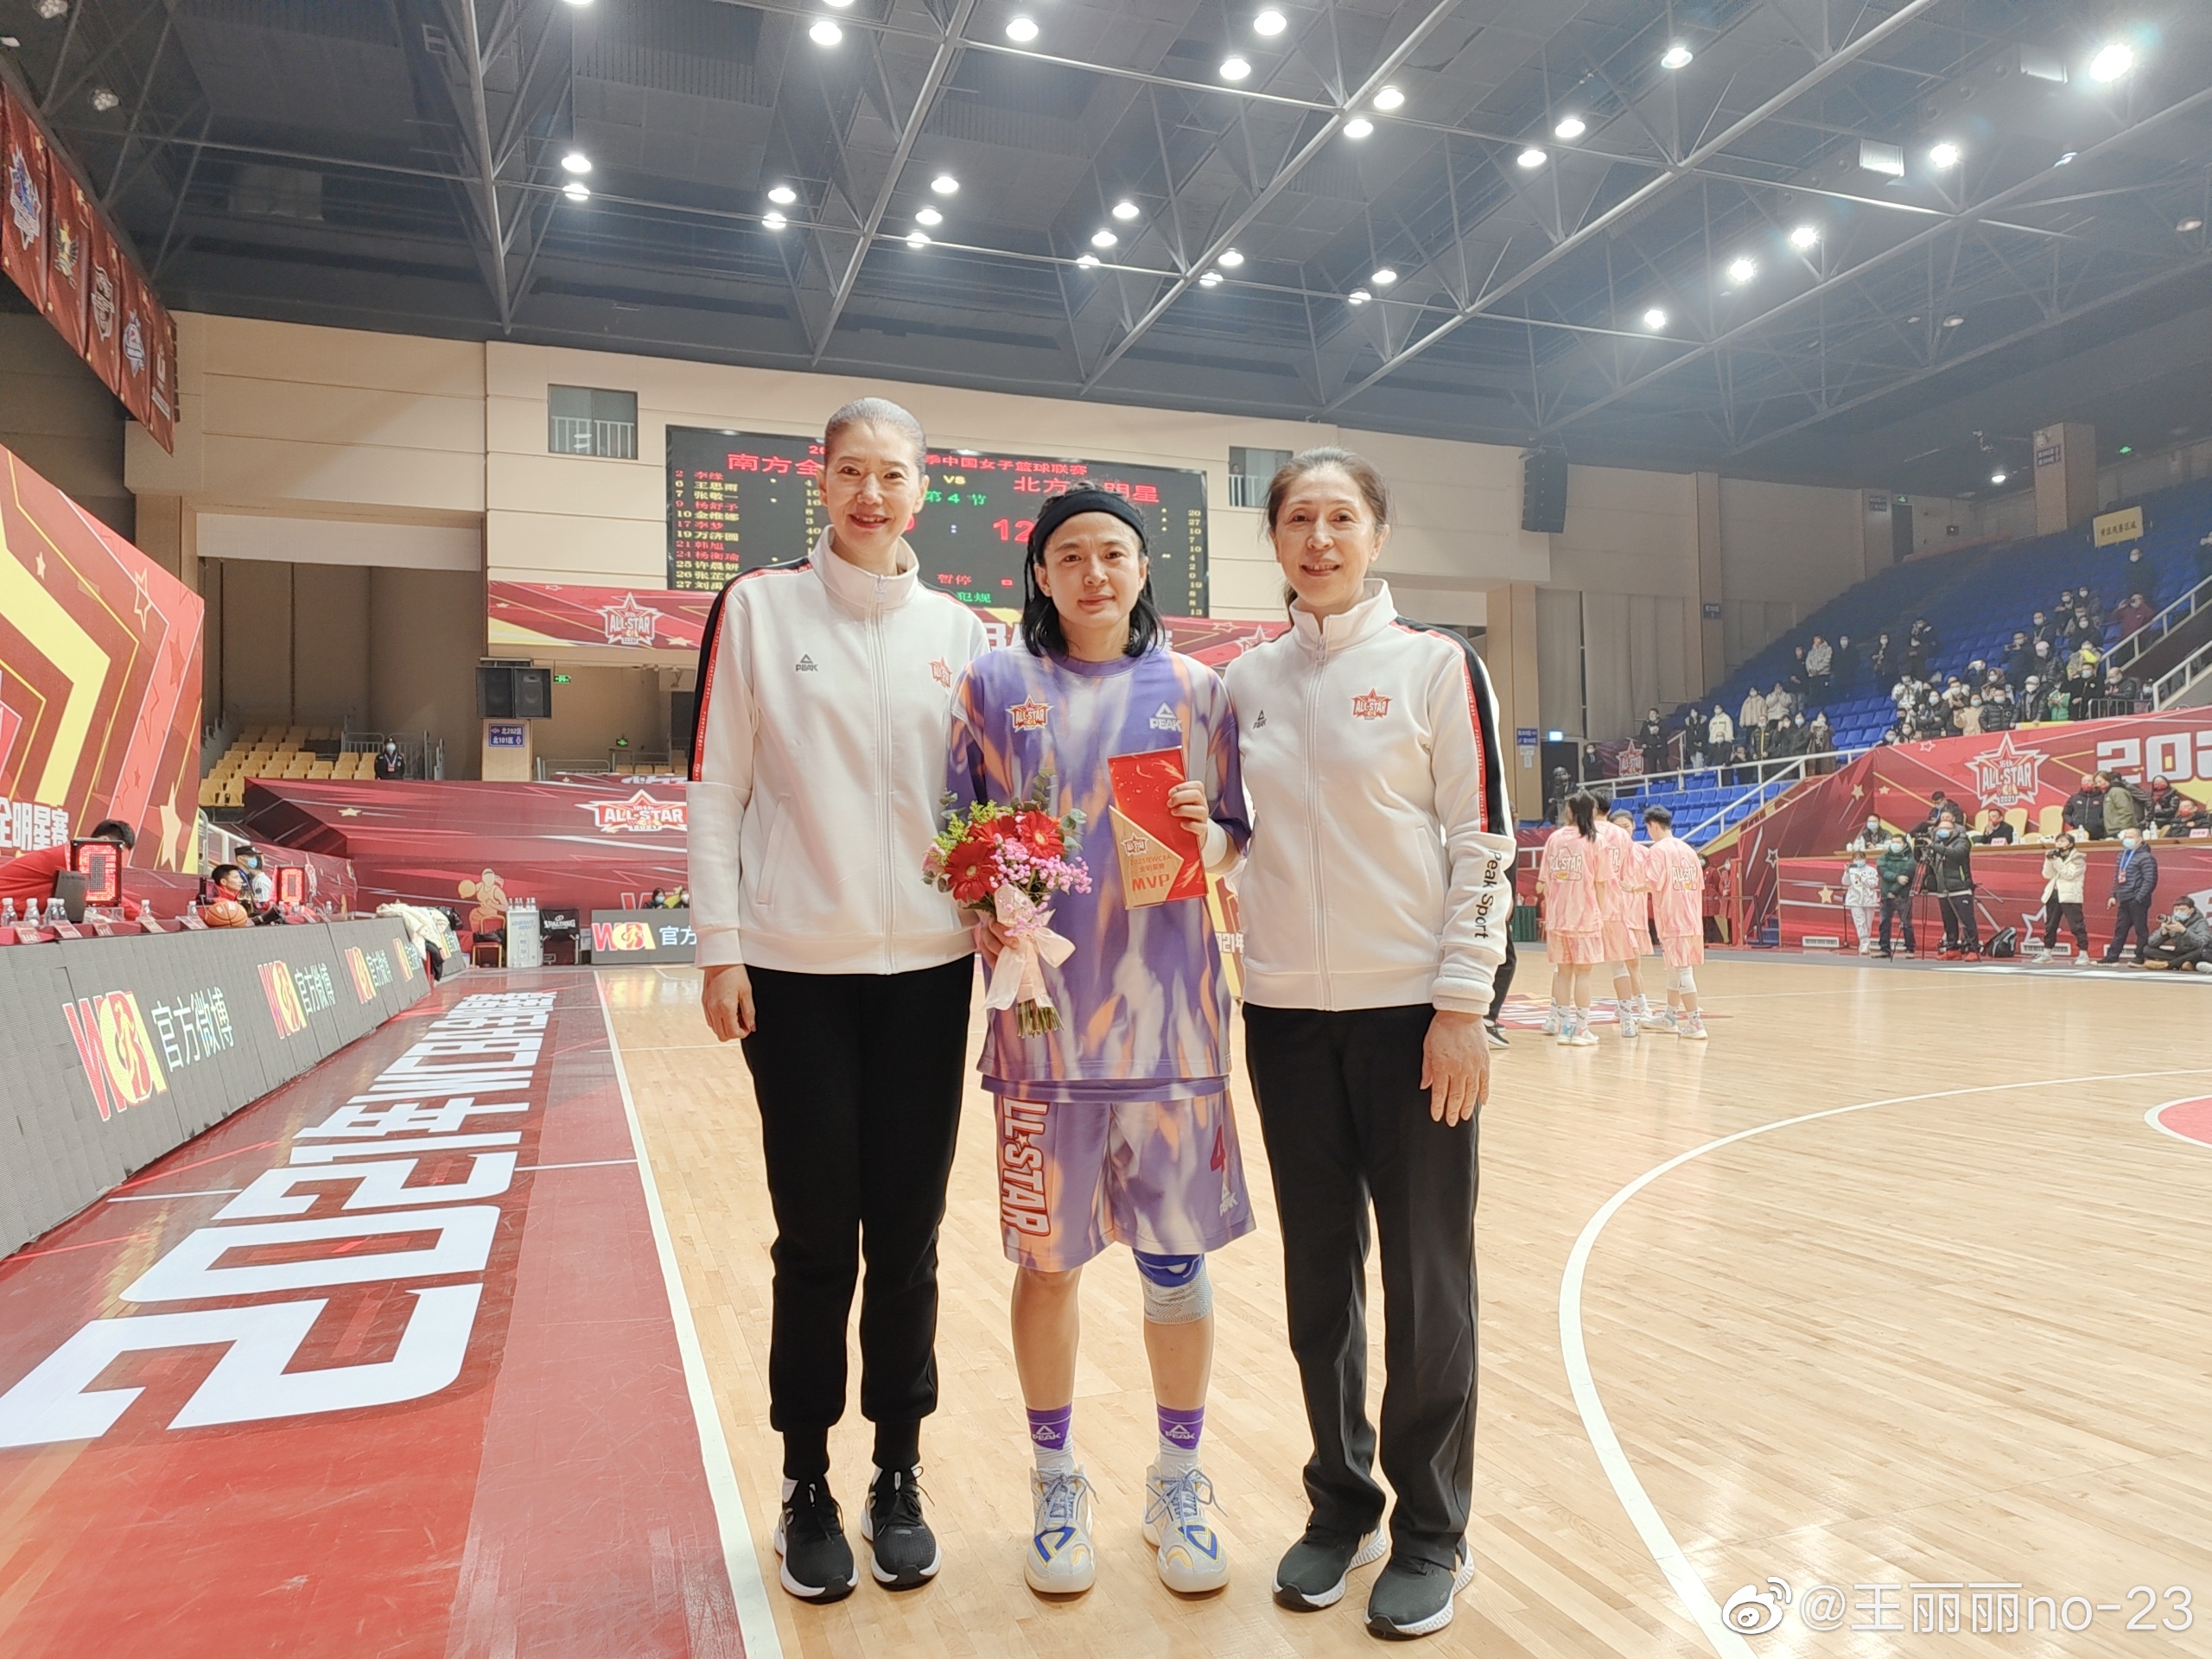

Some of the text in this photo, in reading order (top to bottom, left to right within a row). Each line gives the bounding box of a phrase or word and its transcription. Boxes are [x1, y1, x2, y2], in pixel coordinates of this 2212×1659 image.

[795, 664, 819, 672] PEAK
[1149, 717, 1184, 733] PEAK
[1132, 874, 1171, 891] MVP
[1474, 849, 1503, 939] Peak Sport
[543, 918, 576, 929] SPALDING
[294, 962, 336, 1016] 官方微博
[151, 986, 234, 1072] 官方微博
[1210, 1124, 1226, 1174] 4
[1032, 1432, 1062, 1441] PEAK
[1165, 1430, 1195, 1440] PEAK
